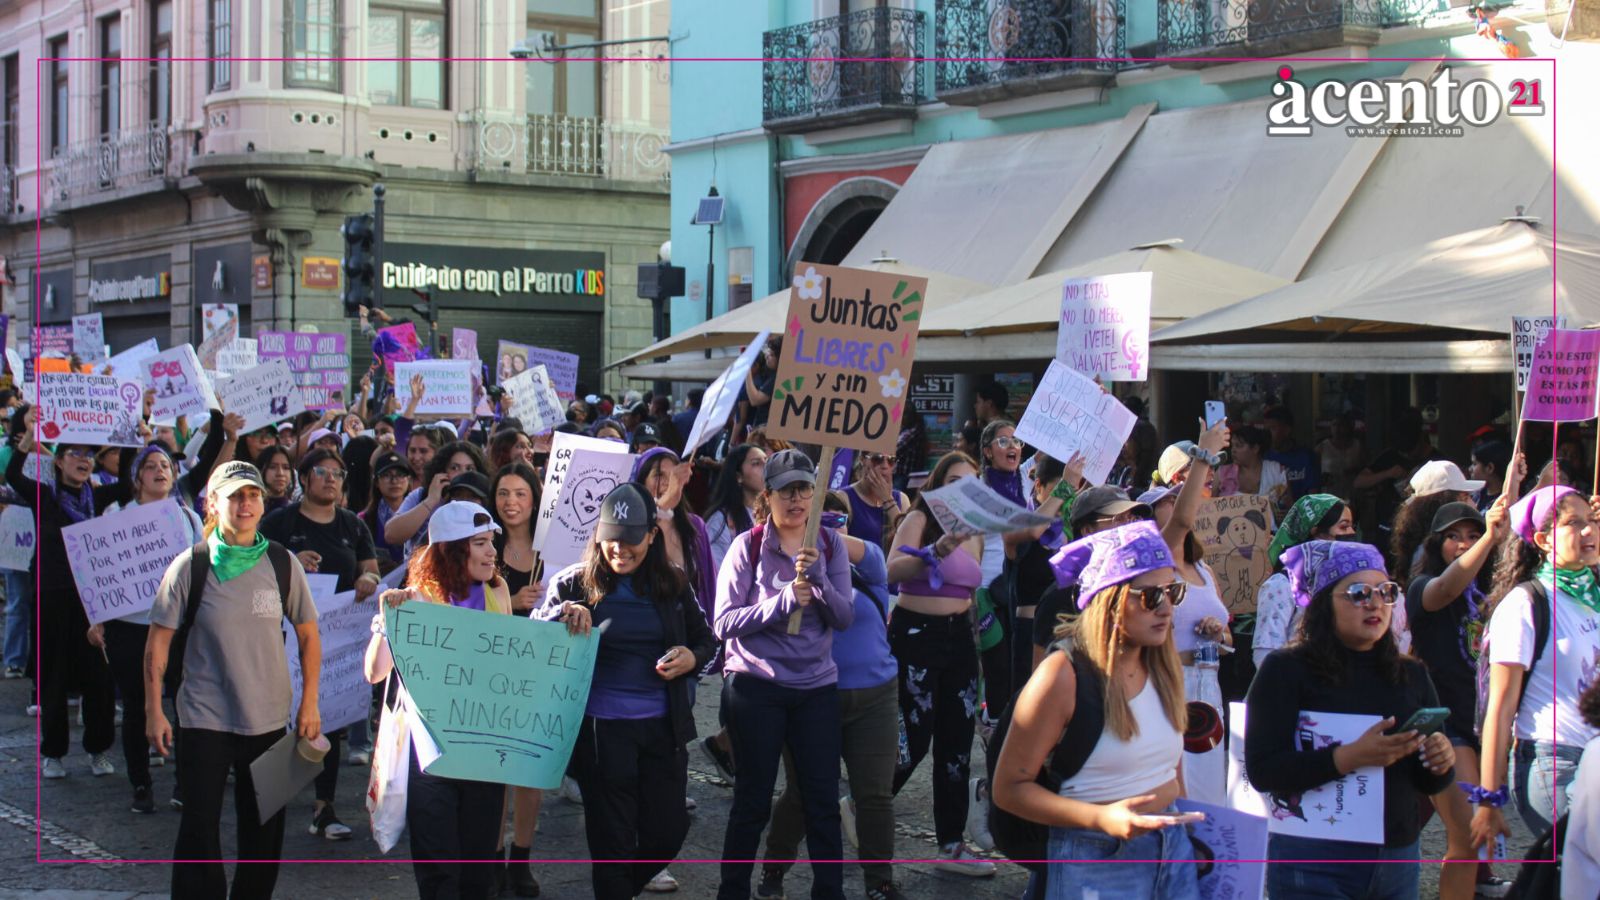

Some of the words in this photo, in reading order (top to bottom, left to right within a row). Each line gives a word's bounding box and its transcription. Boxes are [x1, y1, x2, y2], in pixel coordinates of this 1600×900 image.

[383, 262, 461, 290] Cuidado
[464, 270, 500, 296] con
[503, 267, 520, 292] el
[523, 268, 574, 293] Perro
[576, 269, 604, 295] KIDS
[1065, 284, 1078, 299] NO
[1083, 282, 1109, 300] ESTAS
[811, 277, 902, 331] Juntas
[1062, 309, 1075, 325] NO
[1083, 308, 1096, 325] LO
[1514, 320, 1531, 332] NO
[794, 328, 894, 373] LIBRES
[915, 400, 927, 410] DE
[780, 394, 888, 440] MIEDO
[556, 449, 572, 460] GR
[554, 462, 567, 472] LA
[15, 531, 33, 548] NO
[131, 520, 159, 538] ABUE
[134, 578, 161, 601] TOD
[395, 608, 456, 651] FELIZ
[474, 632, 536, 659] SERA
[547, 645, 577, 671] EL
[444, 663, 474, 686] EN
[489, 672, 536, 698] QUE
[551, 683, 580, 701] NO
[420, 708, 438, 724] TE
[448, 698, 564, 741] NINGUNA
[1356, 775, 1369, 797] Una
